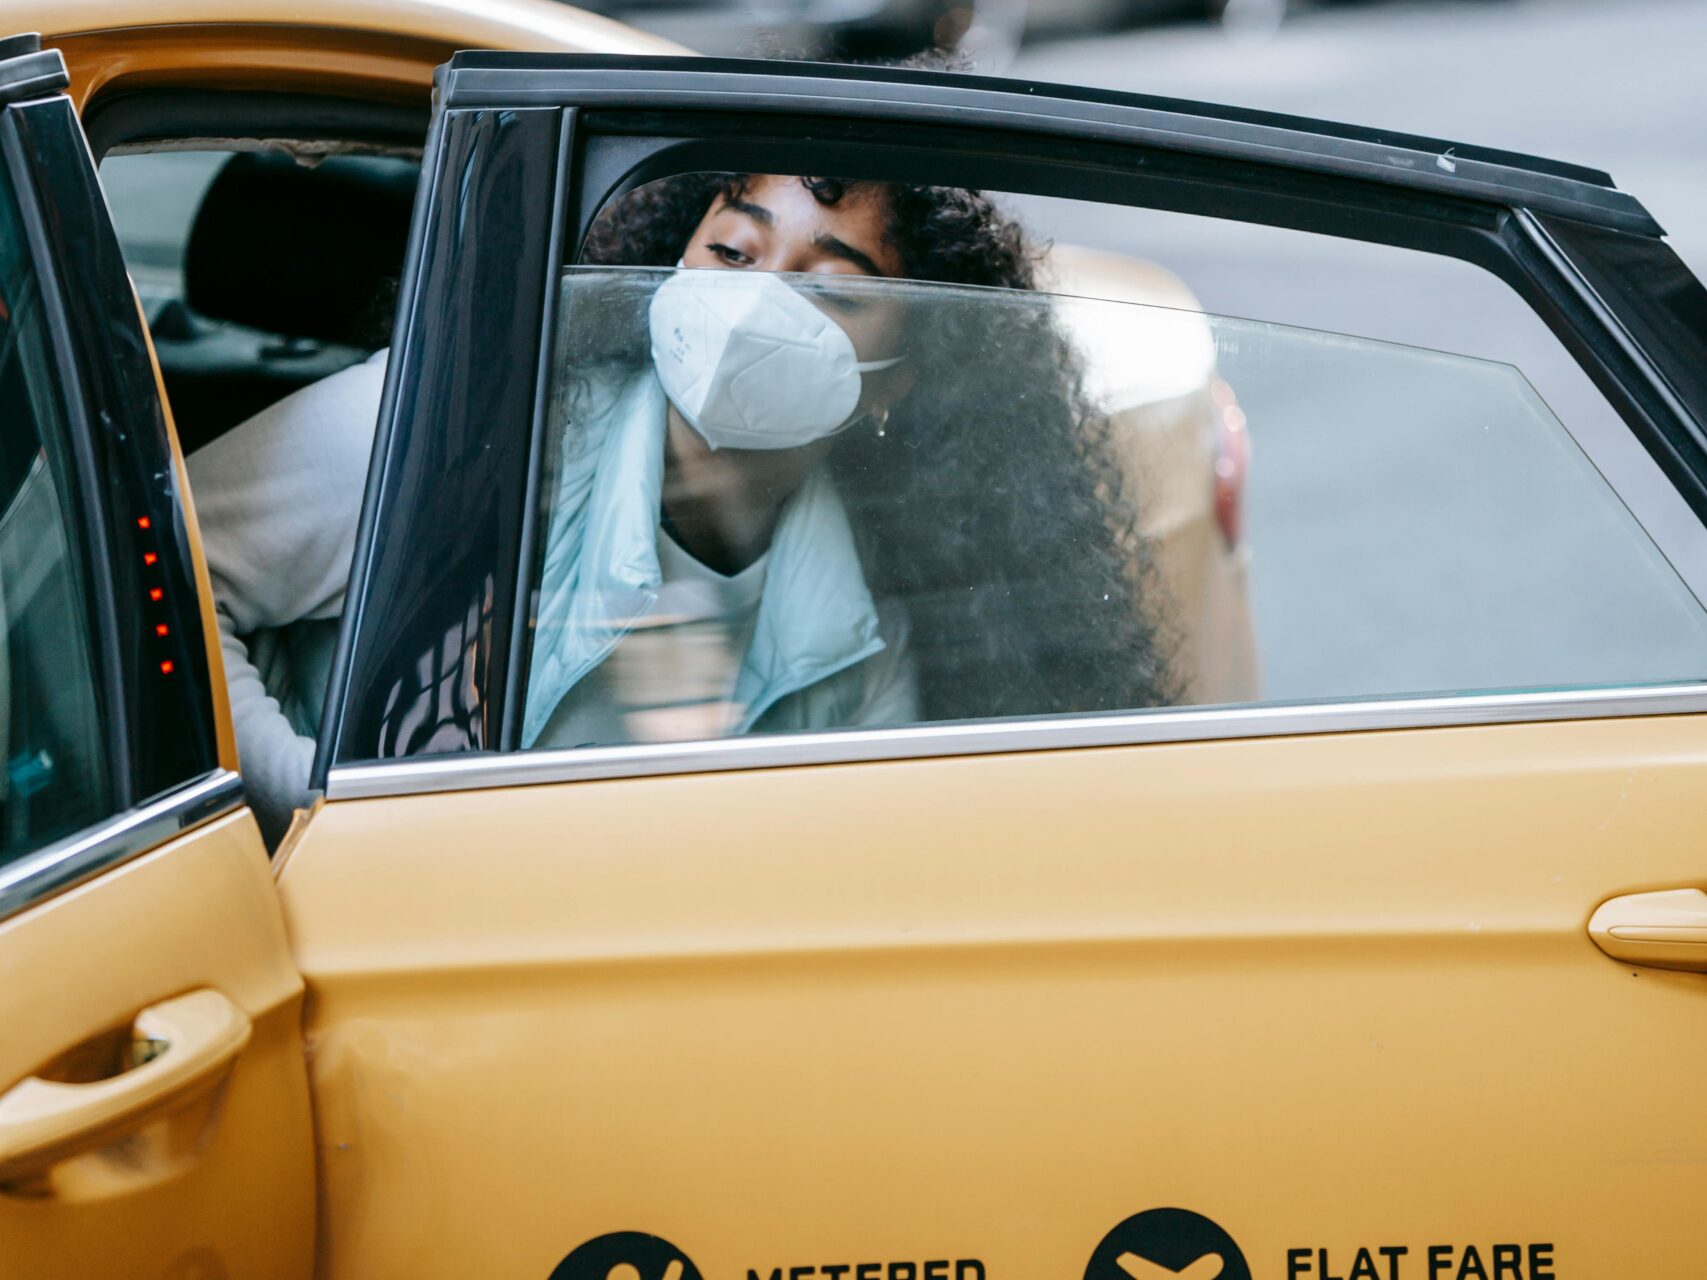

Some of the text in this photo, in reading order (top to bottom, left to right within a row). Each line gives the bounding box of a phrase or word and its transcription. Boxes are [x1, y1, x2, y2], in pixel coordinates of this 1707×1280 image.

[746, 1258, 987, 1280] TRED
[1286, 1243, 1556, 1280] FLAT FARE
